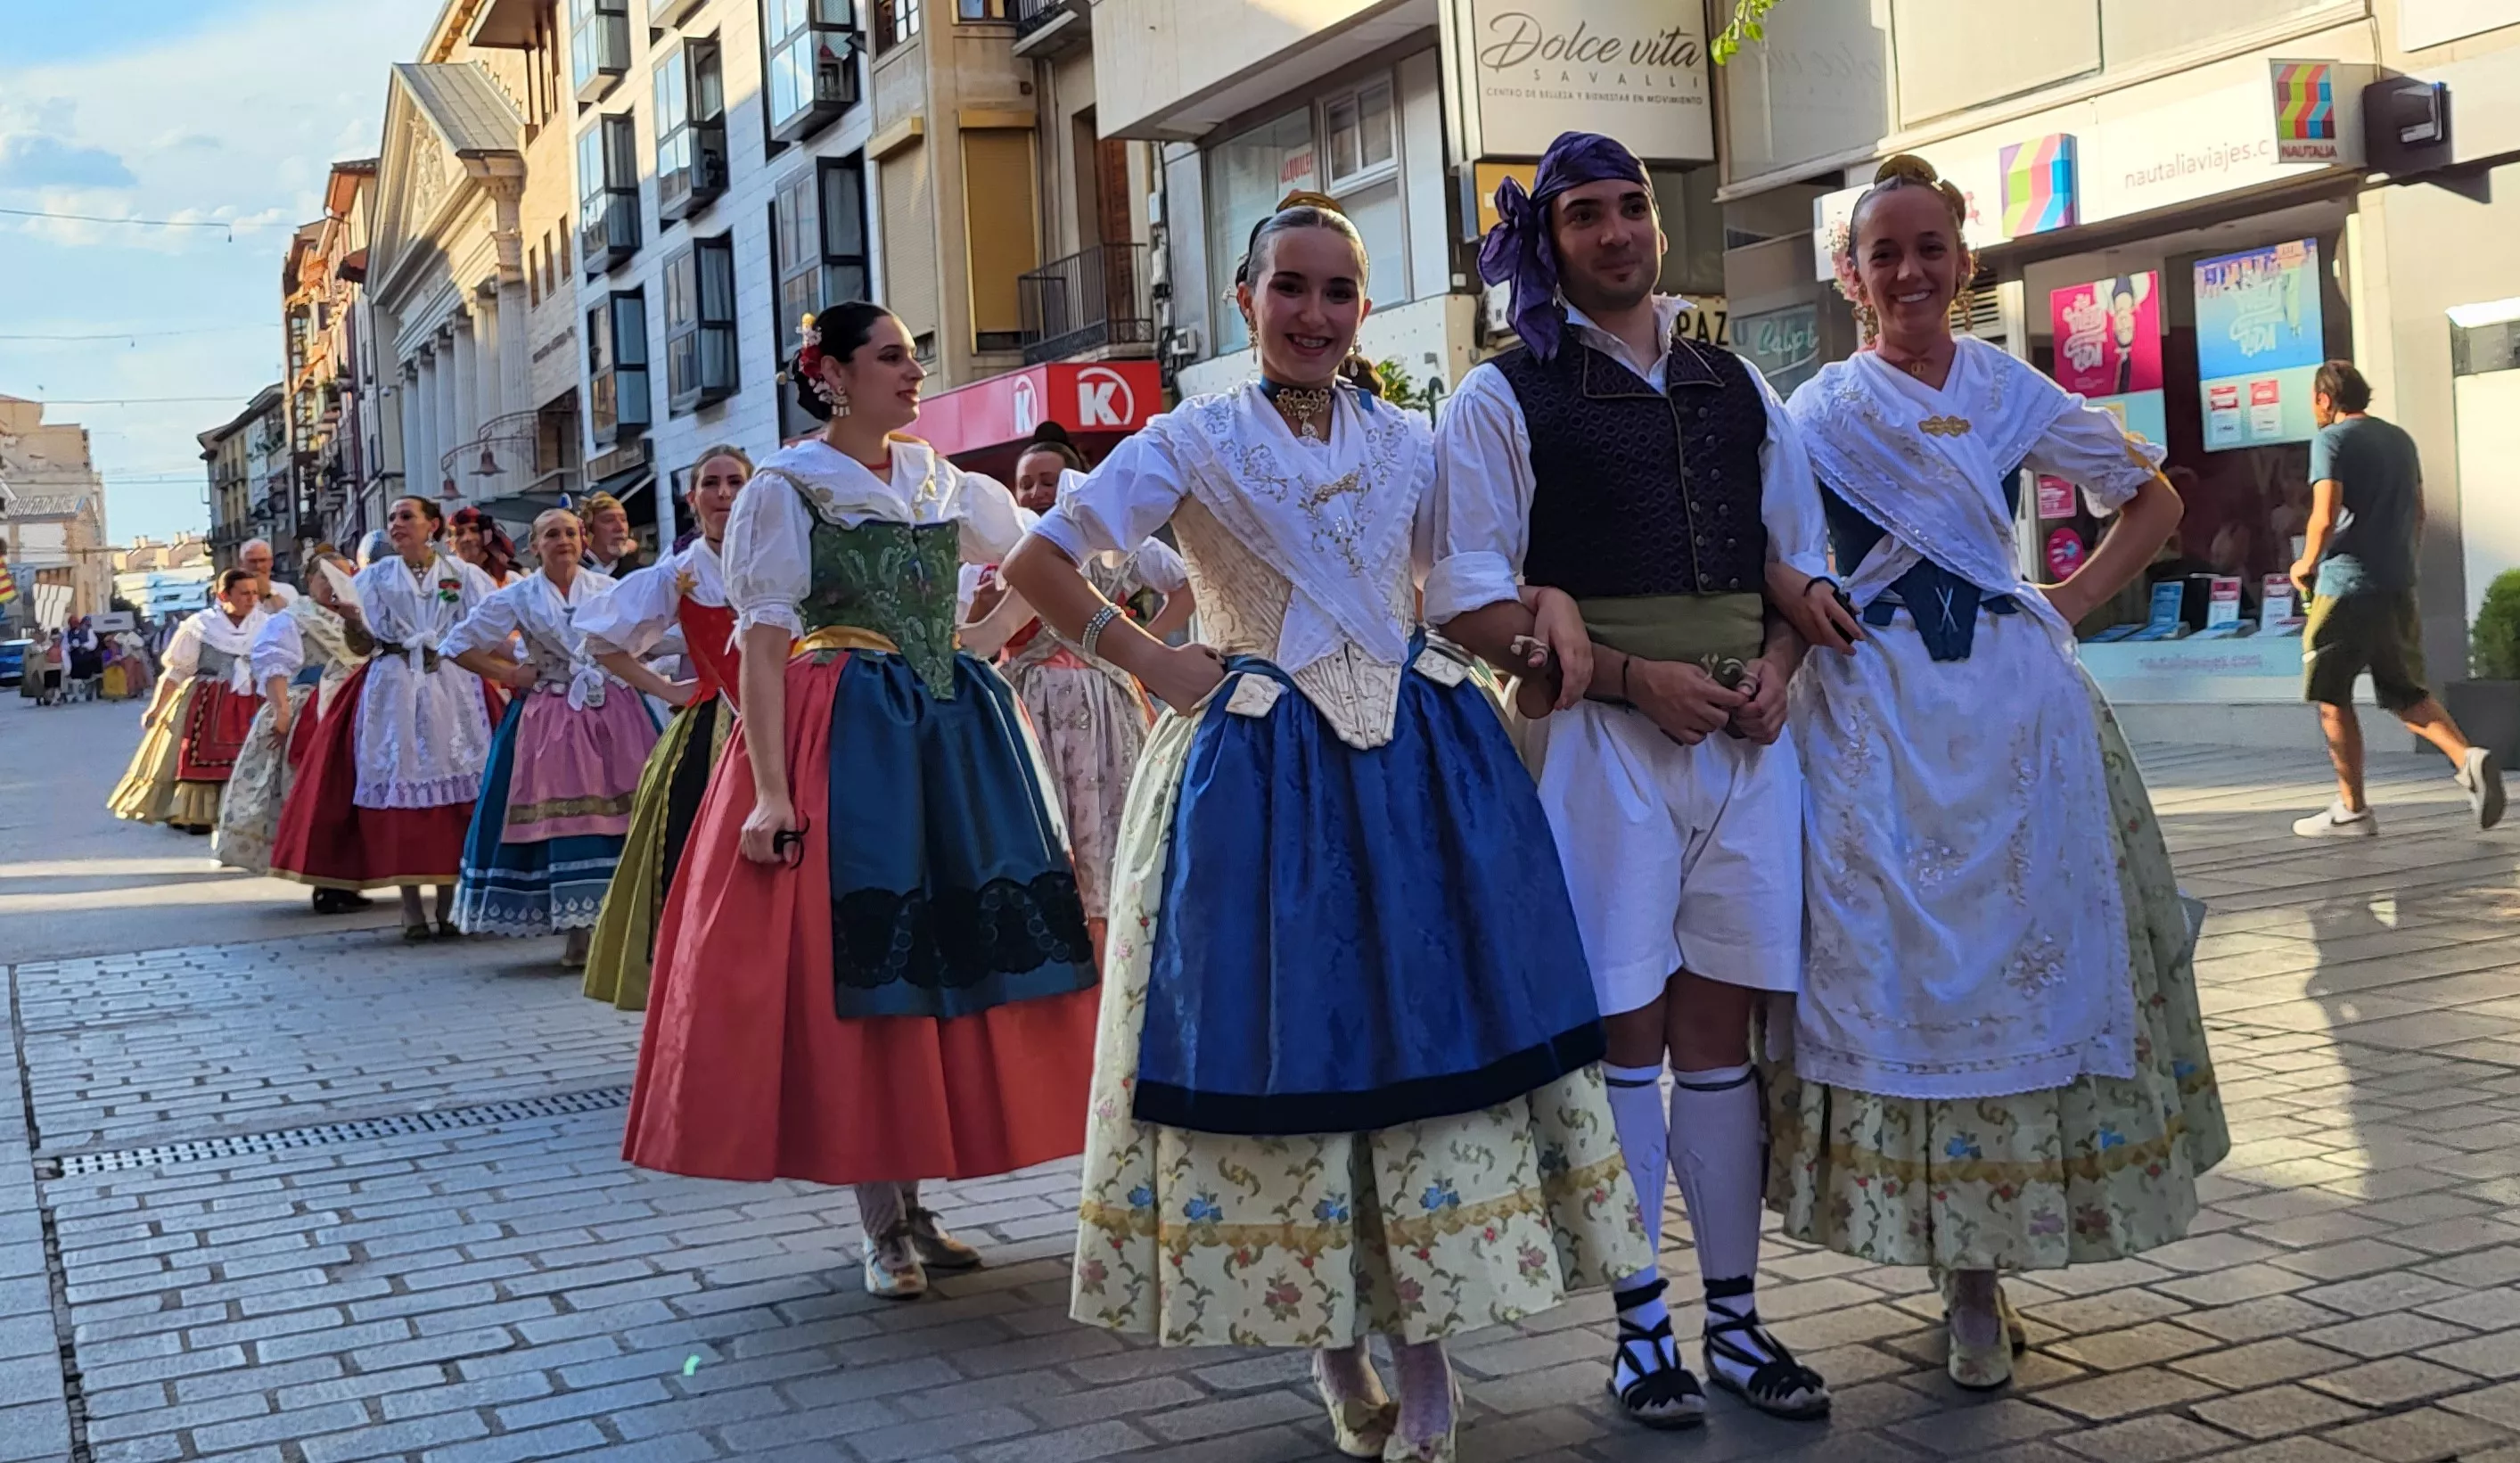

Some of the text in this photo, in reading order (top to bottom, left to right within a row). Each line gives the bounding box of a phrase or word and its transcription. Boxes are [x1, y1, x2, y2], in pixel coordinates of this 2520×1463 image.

[1480, 12, 1703, 73] Dolce vita
[1486, 87, 1523, 97] CENTRO
[1525, 88, 1536, 98] DE
[1632, 94, 1645, 103] EN
[2281, 144, 2338, 159] NAUTALIA
[1079, 382, 1125, 427] K
